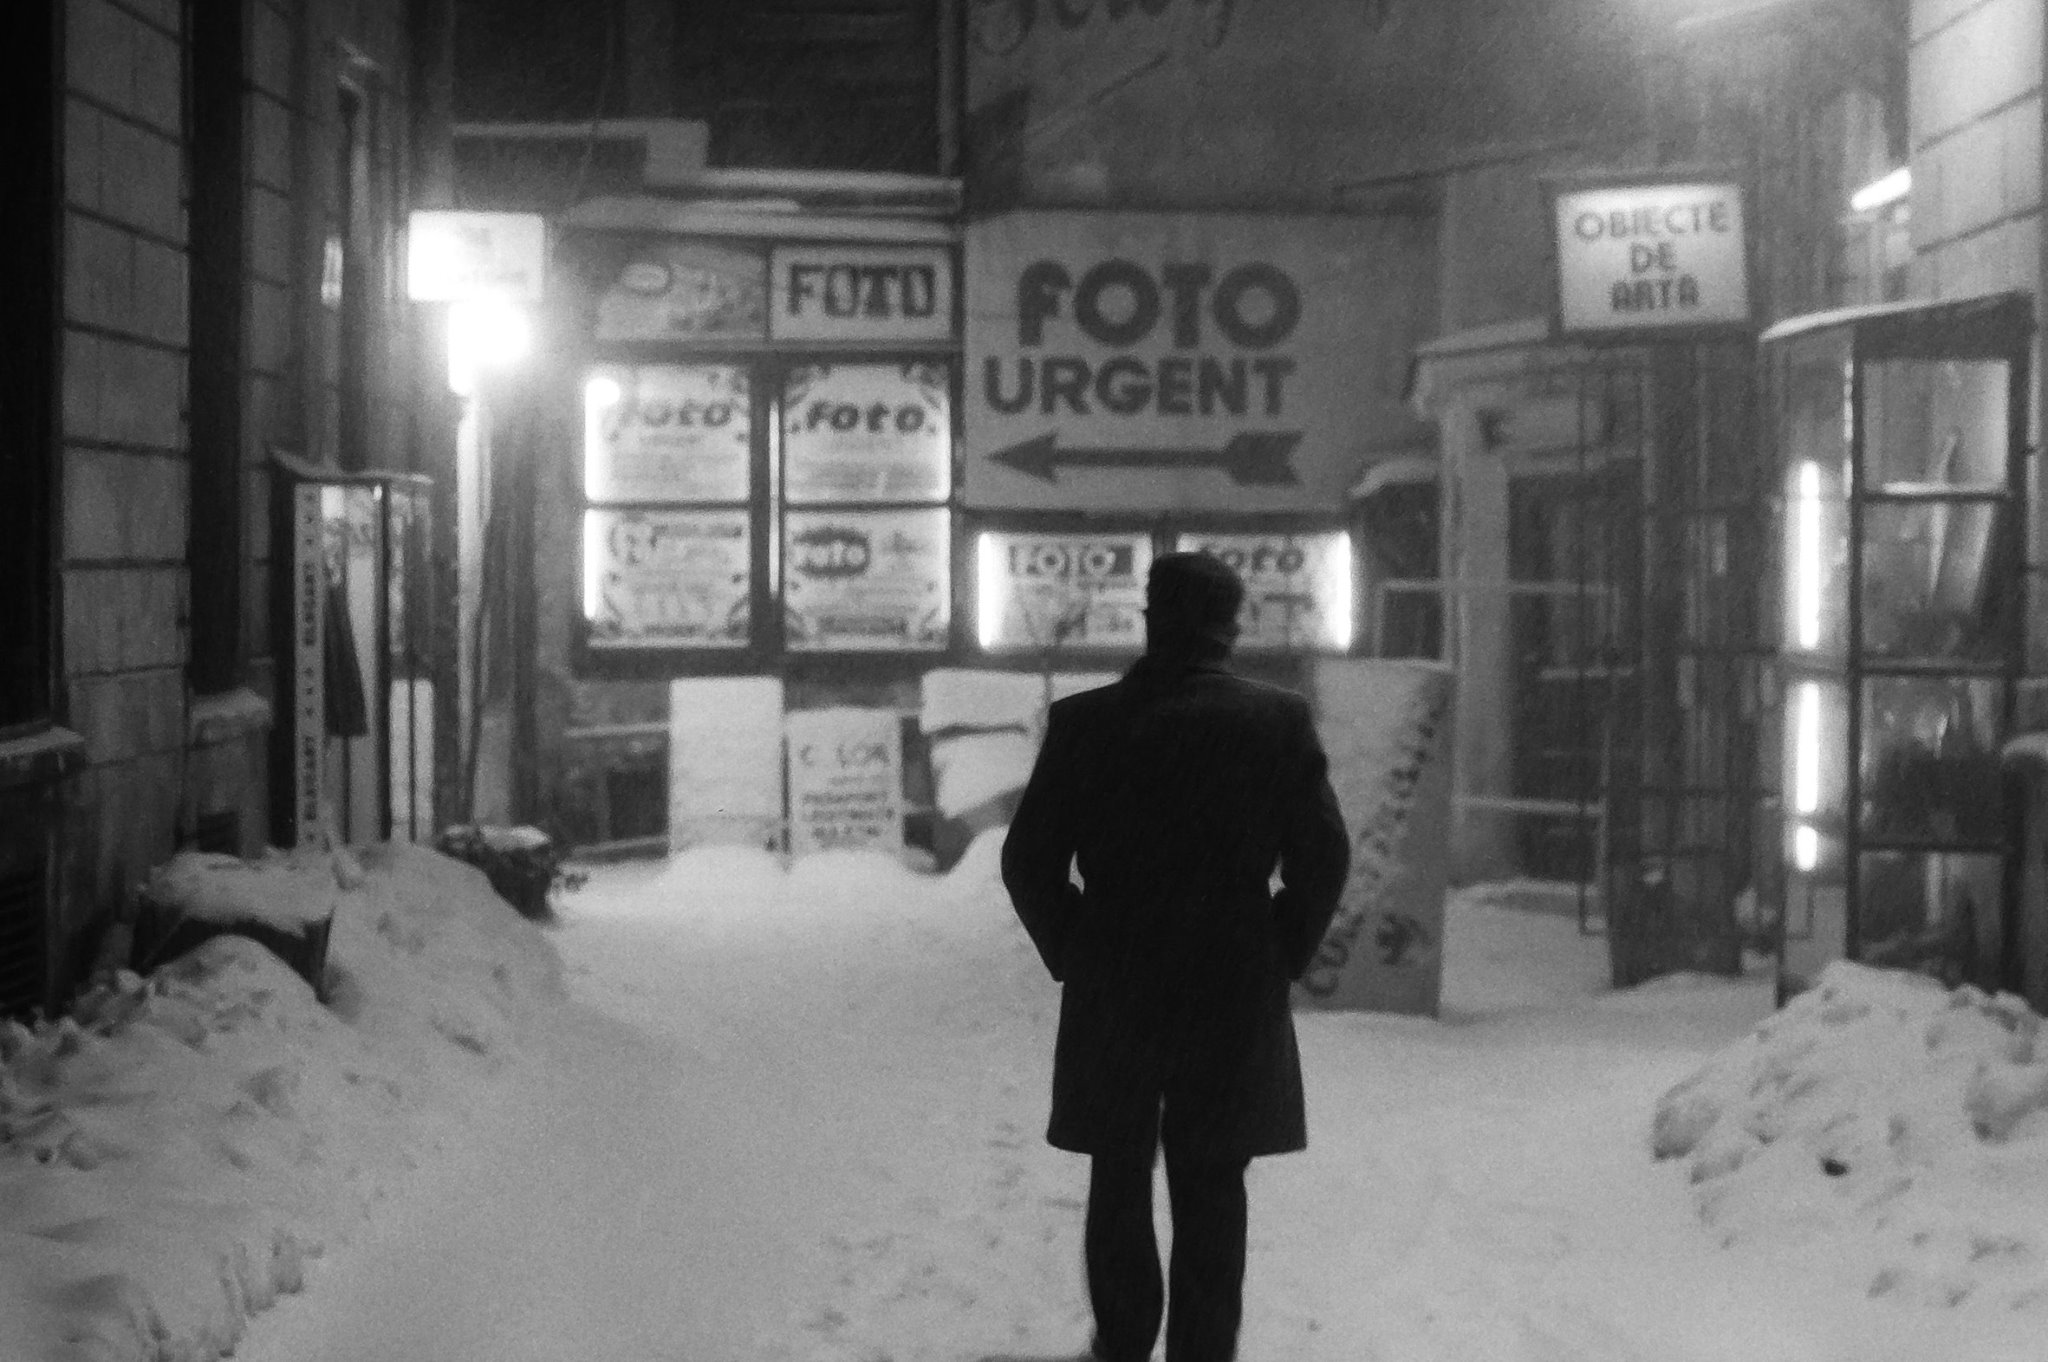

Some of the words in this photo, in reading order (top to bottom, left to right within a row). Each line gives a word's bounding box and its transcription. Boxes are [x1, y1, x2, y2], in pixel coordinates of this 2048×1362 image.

[1574, 202, 1731, 242] OBIECTE
[1631, 241, 1677, 273] DE
[789, 264, 934, 318] FOTO
[1019, 260, 1301, 348] FOTO
[982, 354, 1297, 418] URGENT
